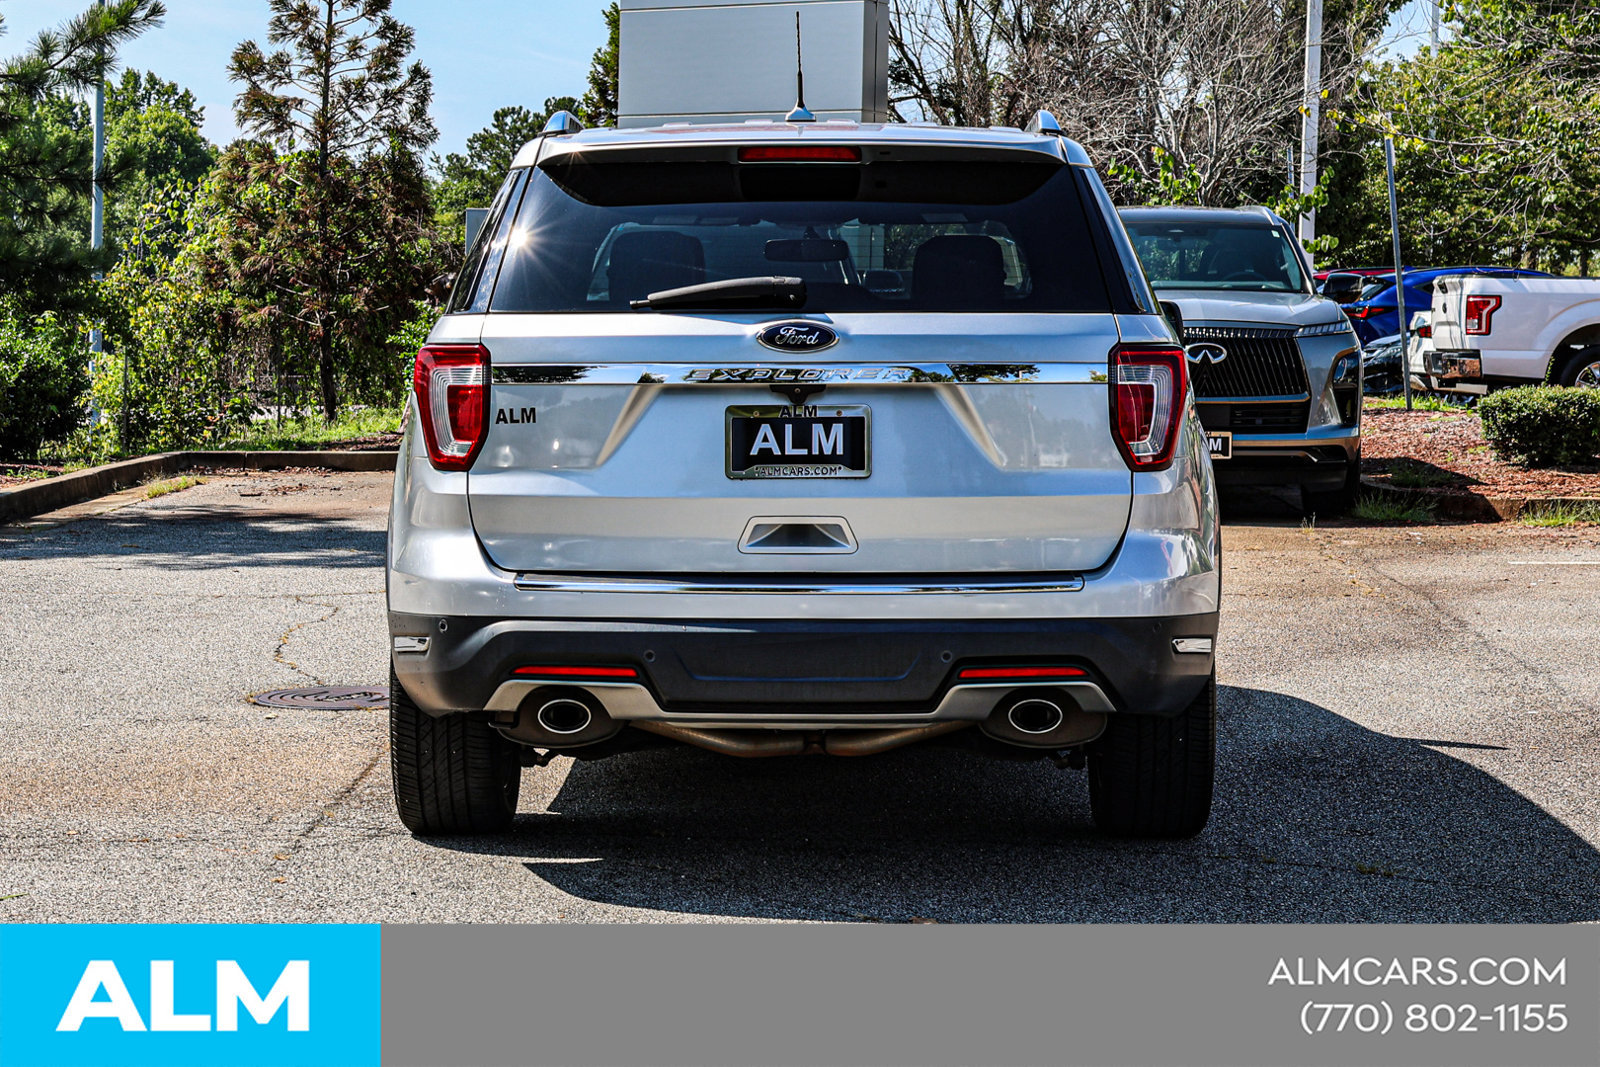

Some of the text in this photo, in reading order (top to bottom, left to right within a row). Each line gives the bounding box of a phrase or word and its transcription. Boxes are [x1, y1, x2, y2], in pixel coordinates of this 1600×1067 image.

[775, 326, 820, 345] Ford
[684, 367, 913, 382] EXPLORER
[495, 407, 537, 425] ALM
[779, 405, 818, 418] ALM
[750, 423, 844, 456] ALM
[758, 465, 838, 477] ALMCARS.COM
